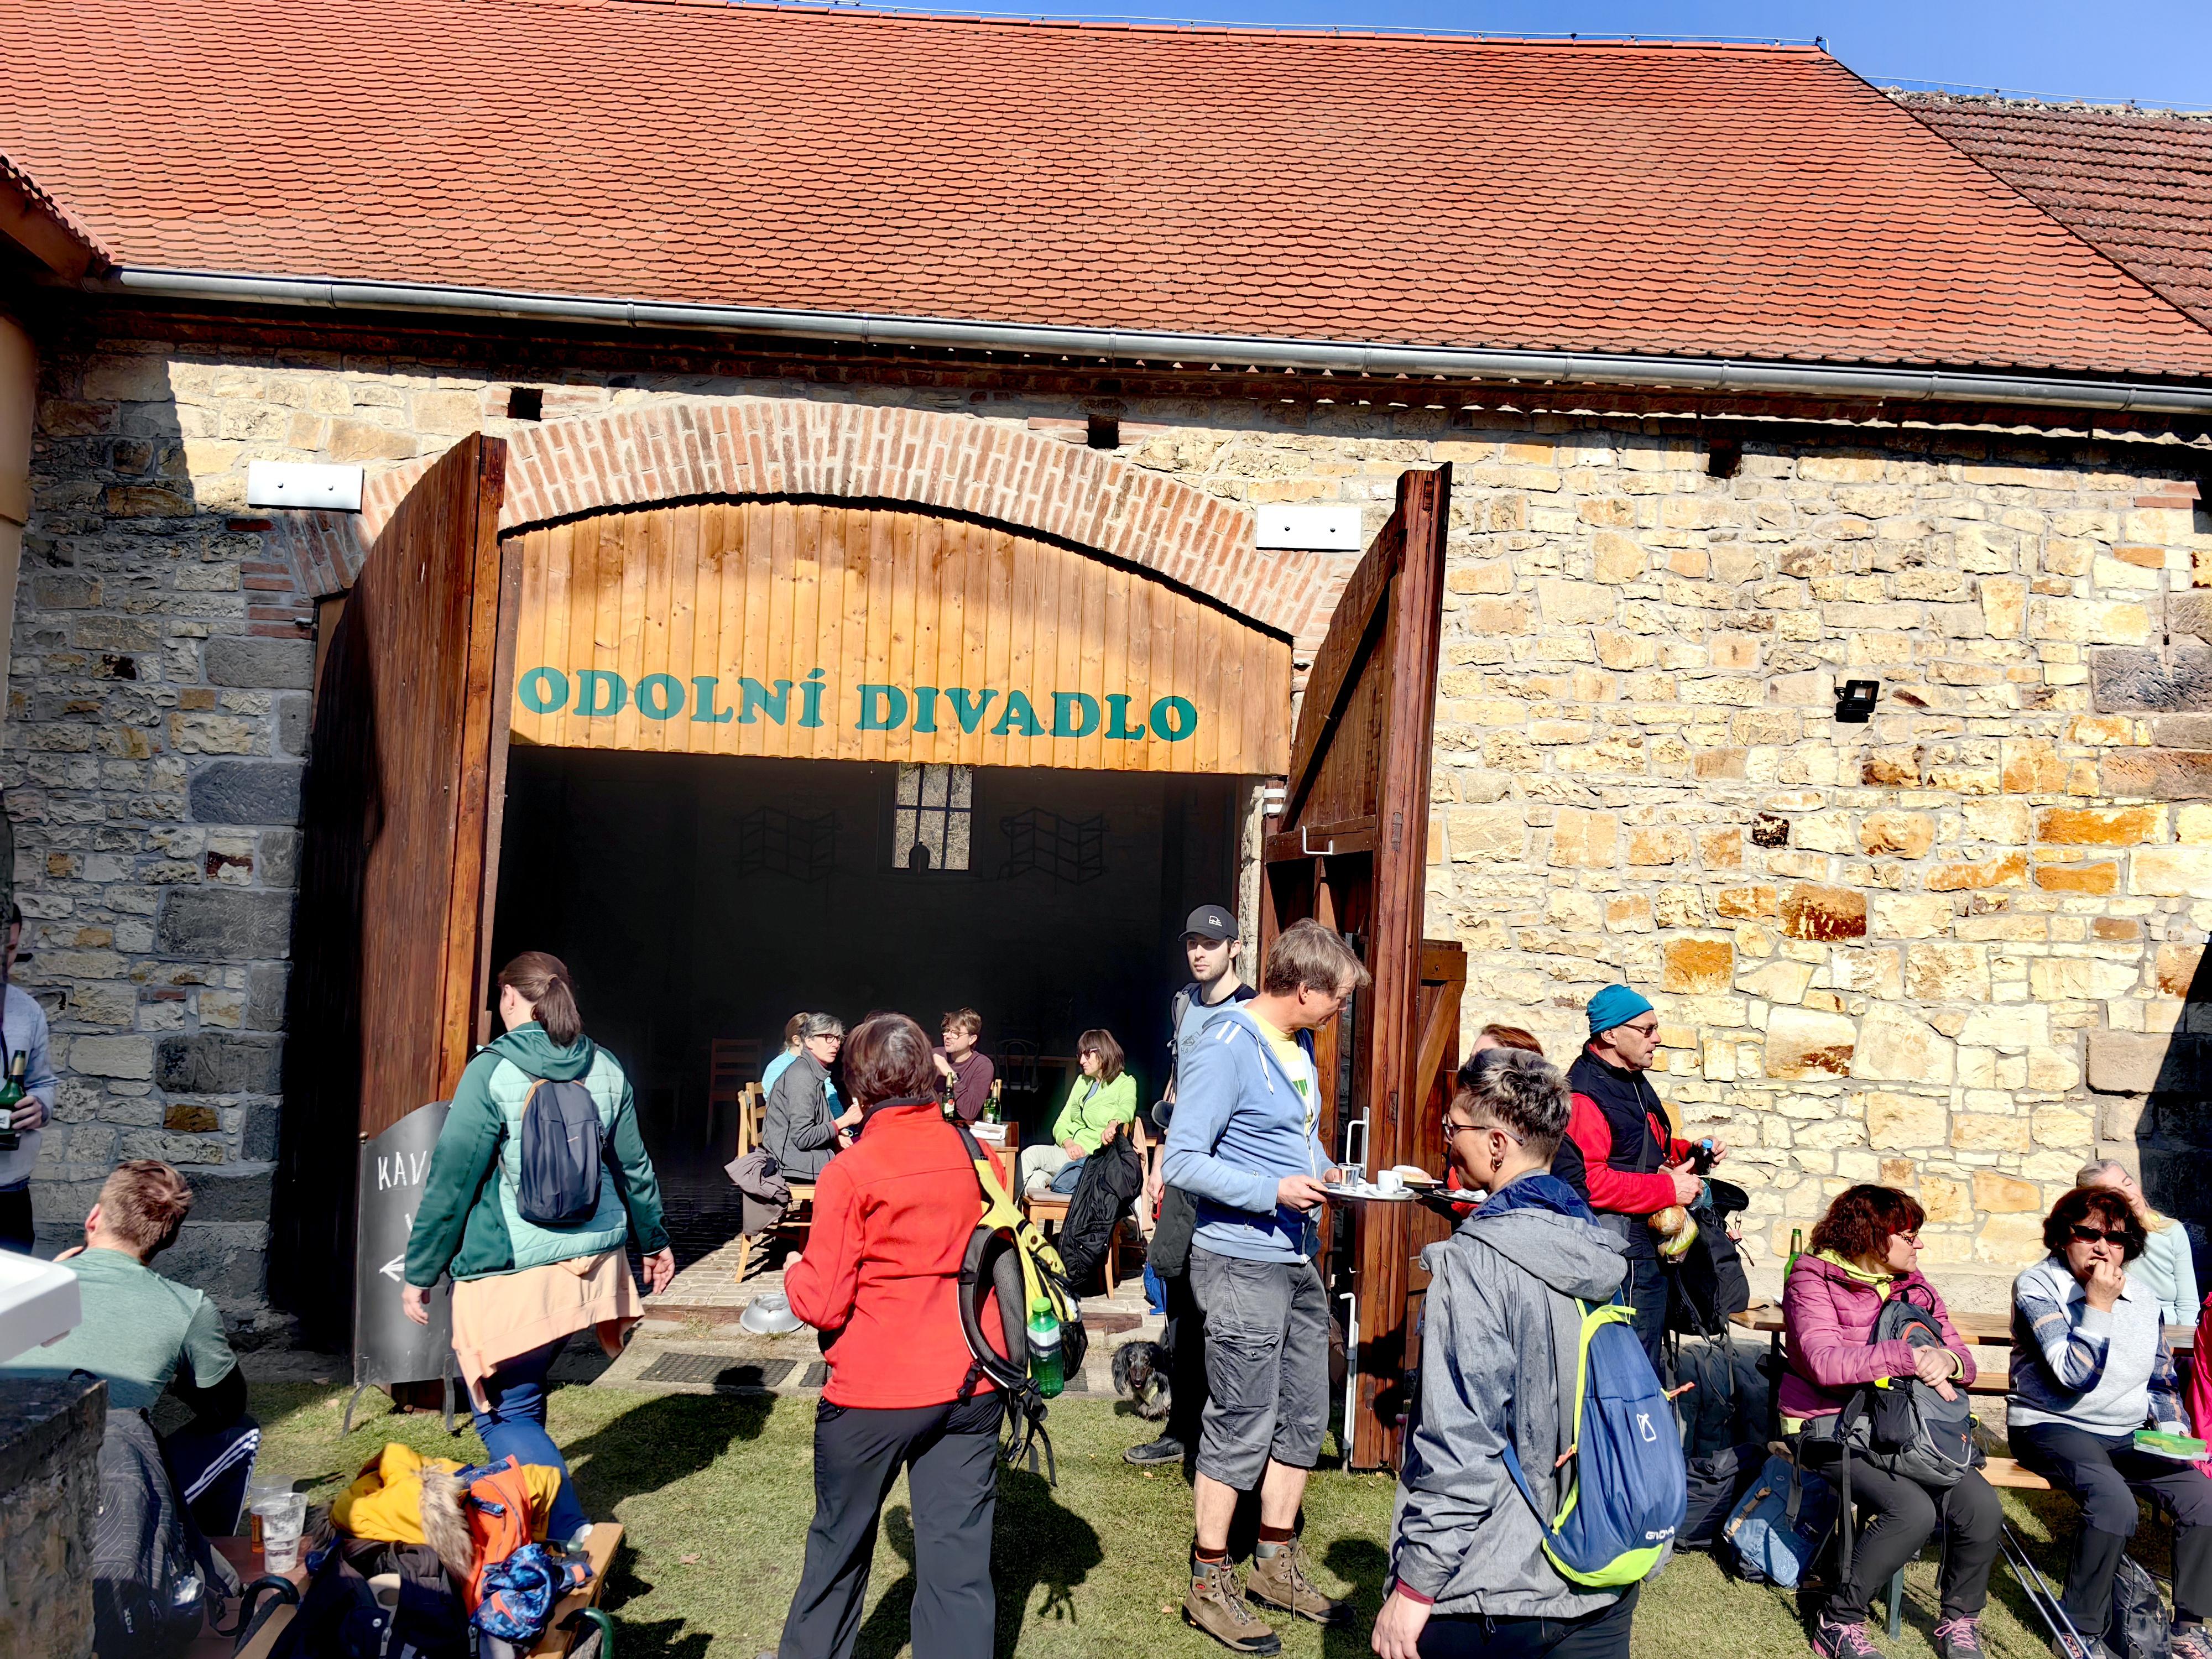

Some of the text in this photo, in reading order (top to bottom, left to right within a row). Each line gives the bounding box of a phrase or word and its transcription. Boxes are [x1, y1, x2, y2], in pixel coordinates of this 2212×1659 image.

[518, 667, 1198, 742] ODOLNÍ DIVADLO
[378, 1150, 431, 1191] KAV
